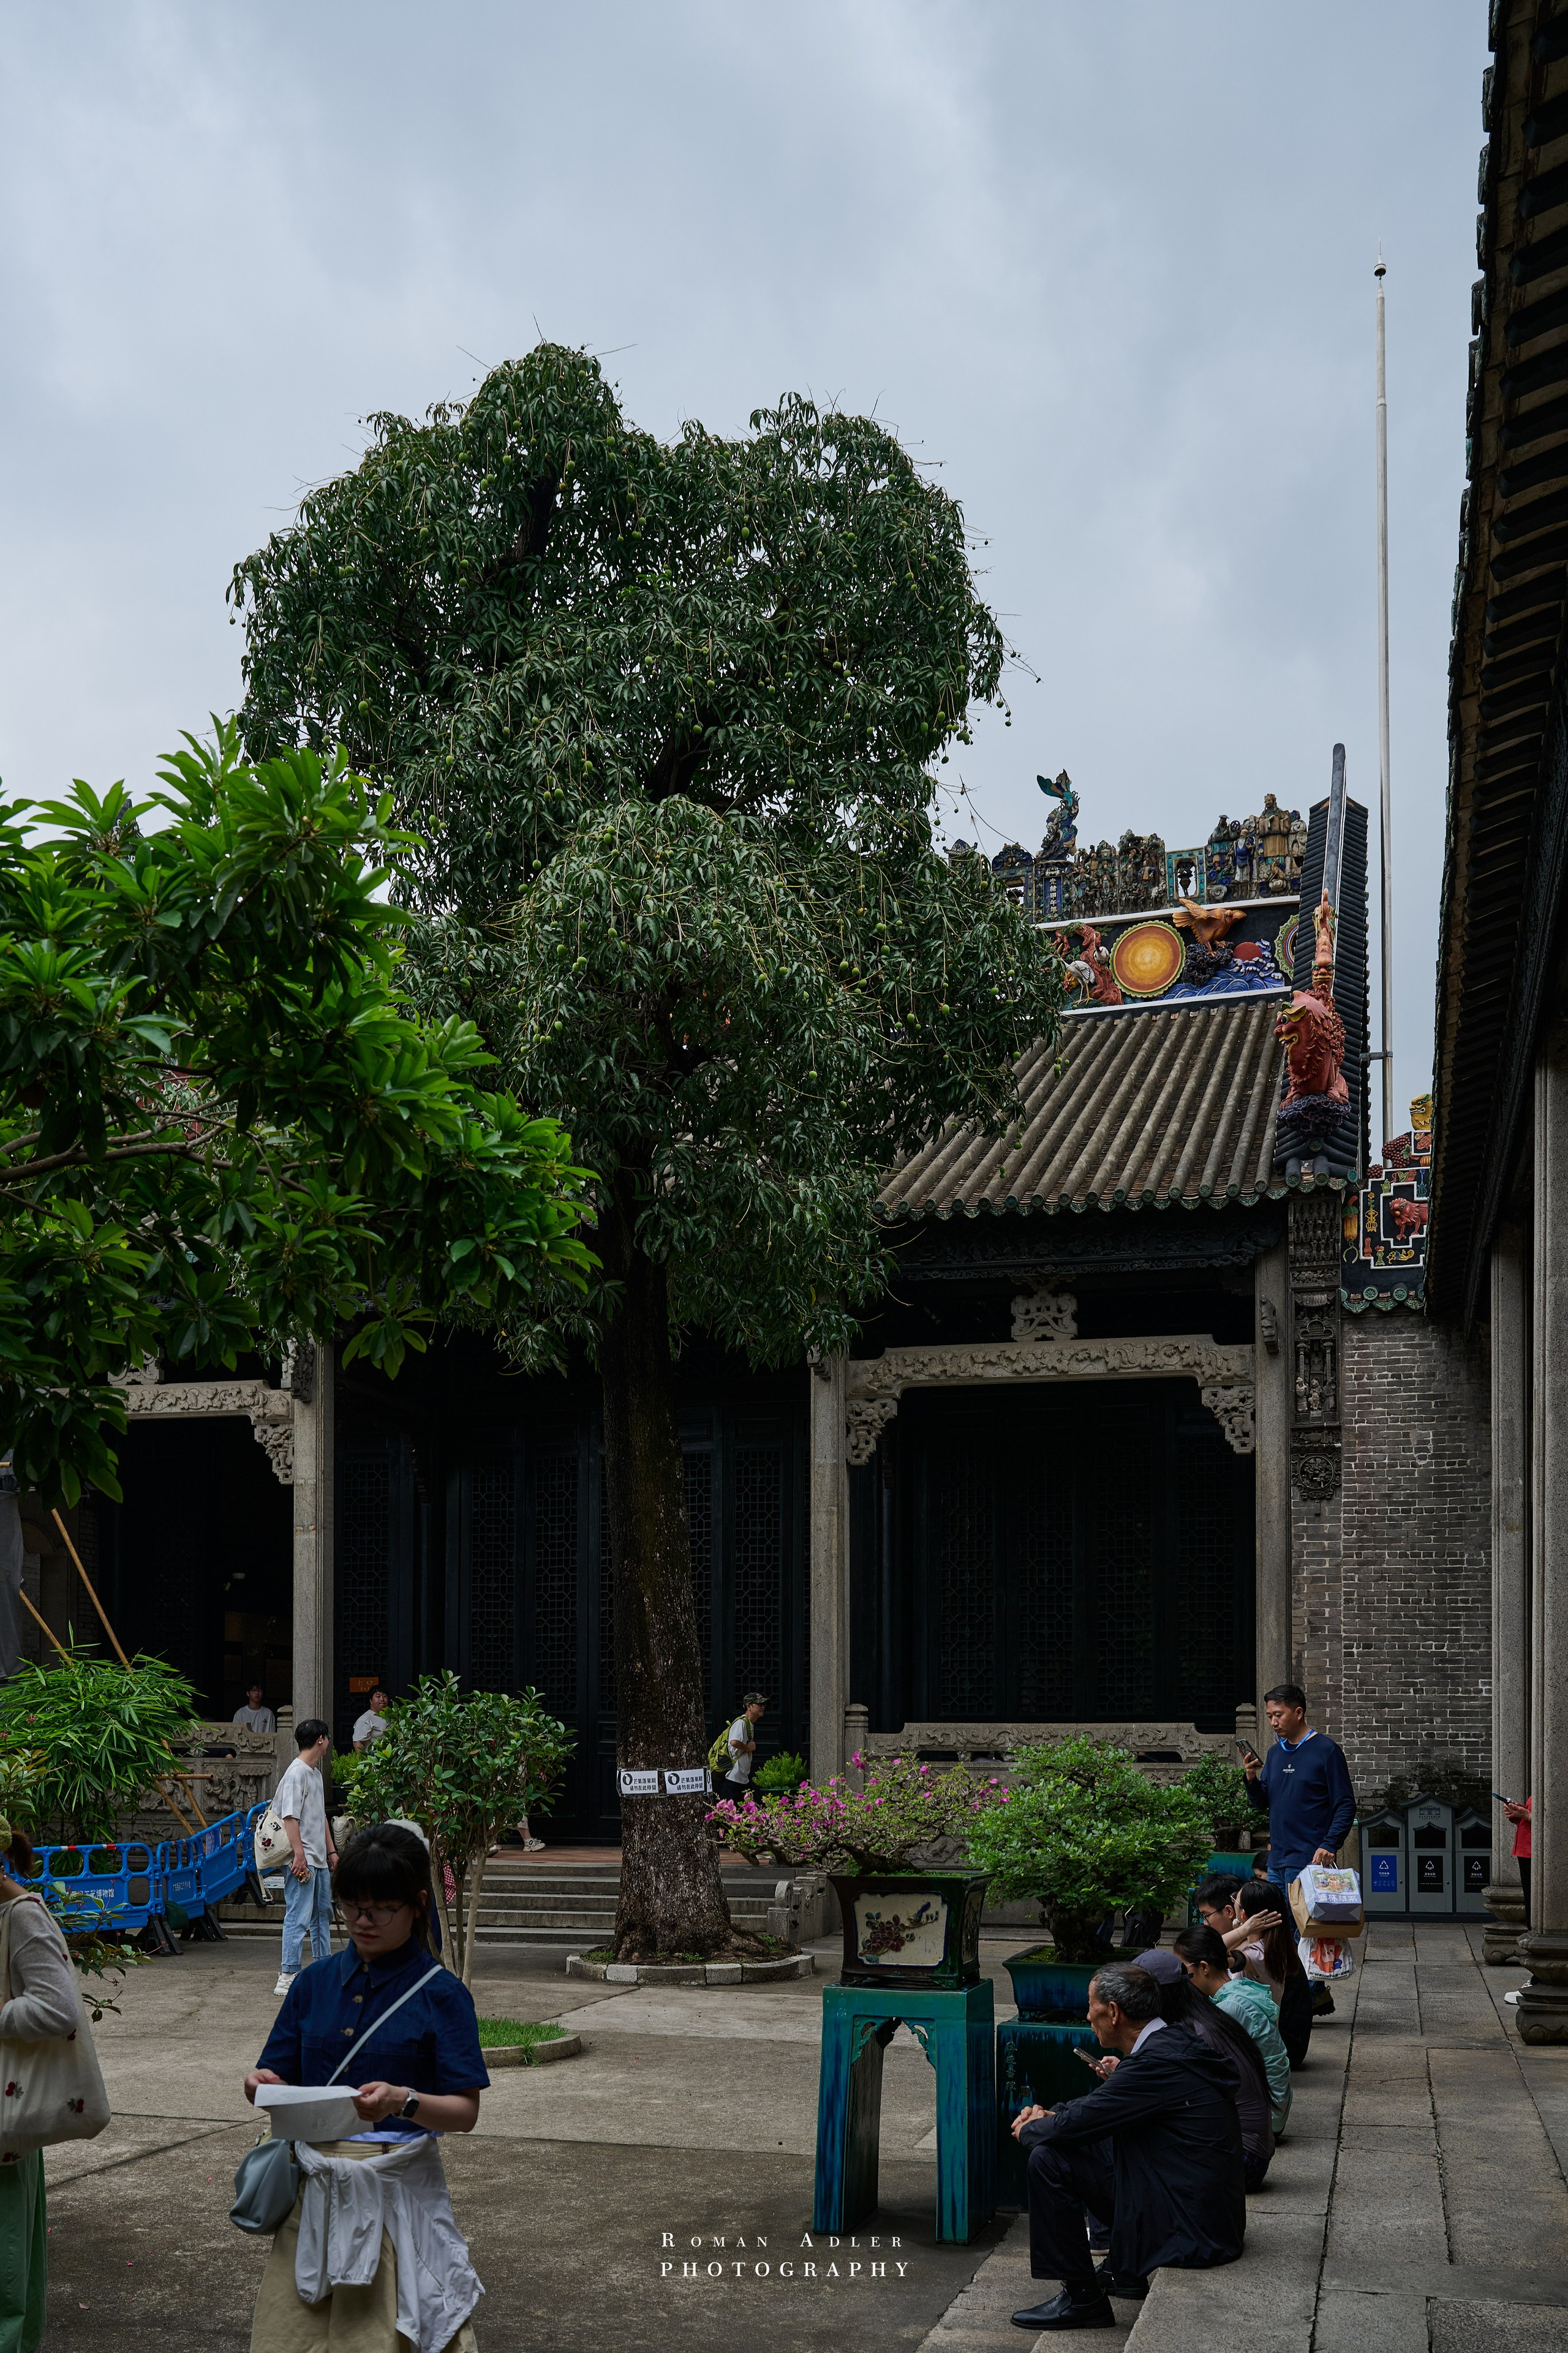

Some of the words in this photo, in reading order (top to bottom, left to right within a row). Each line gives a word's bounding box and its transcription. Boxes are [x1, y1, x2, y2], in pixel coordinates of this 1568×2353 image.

[60, 1889, 115, 1901] 工艺博物馆
